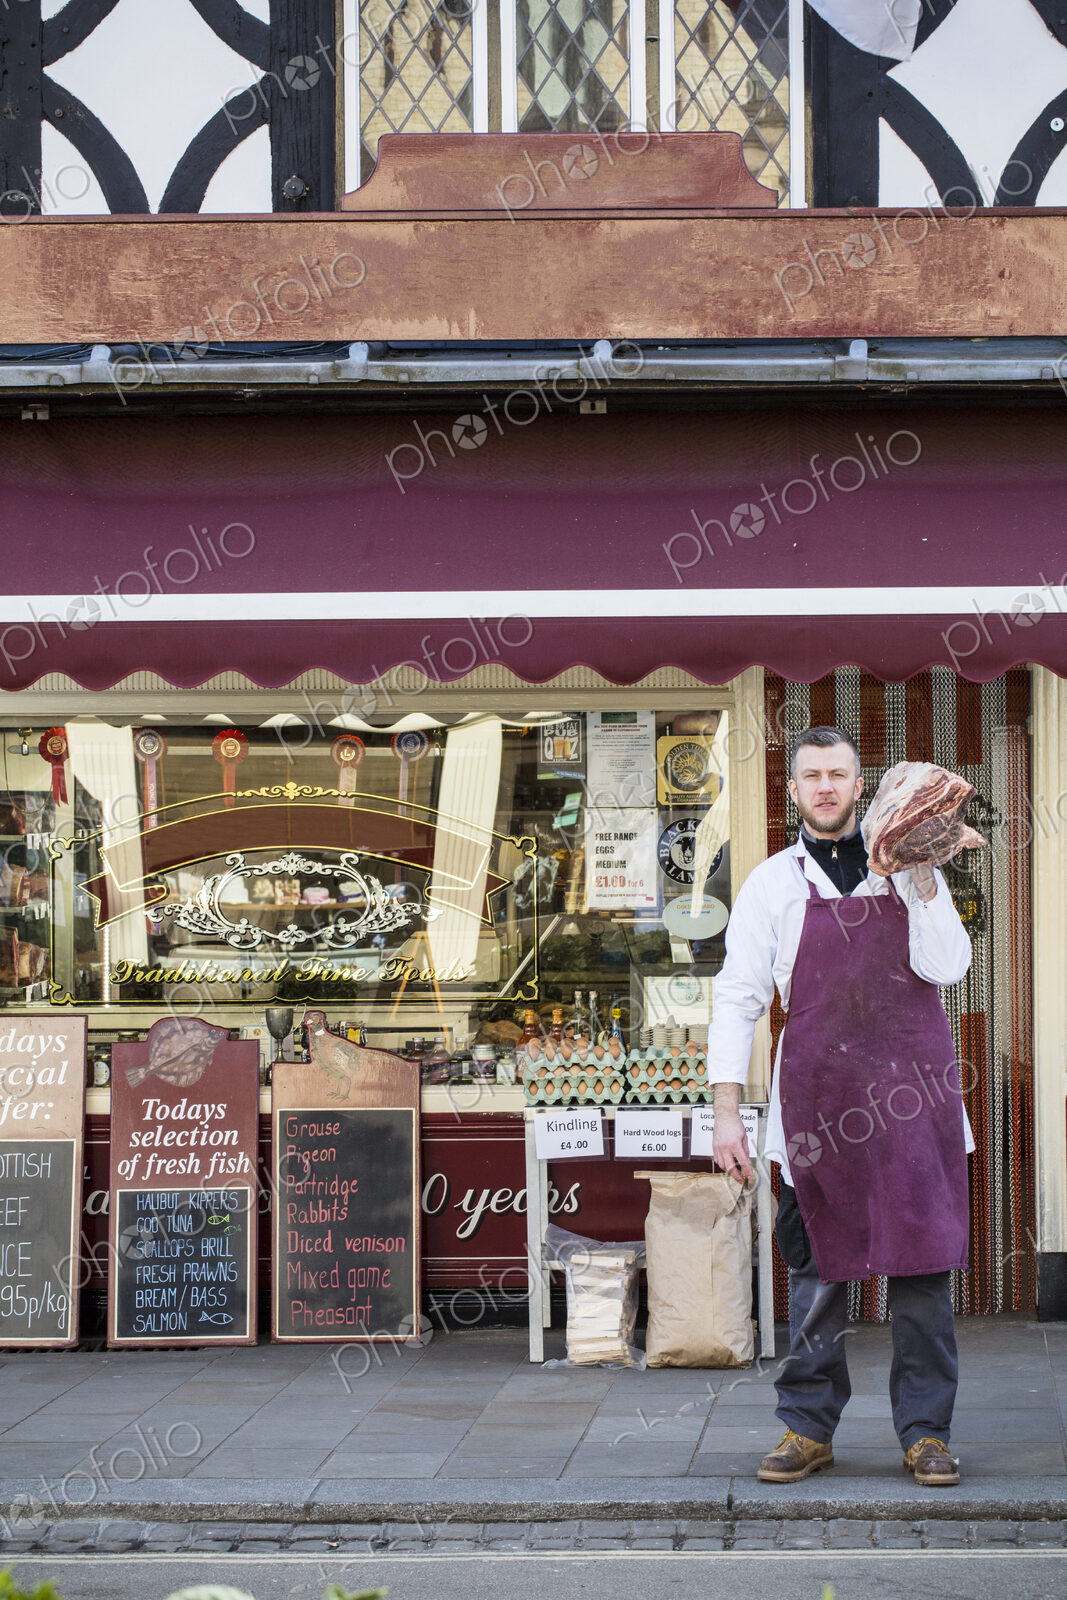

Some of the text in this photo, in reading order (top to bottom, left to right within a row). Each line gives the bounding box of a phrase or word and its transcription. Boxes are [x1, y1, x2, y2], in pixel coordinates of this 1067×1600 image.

[544, 729, 578, 737] PUB
[595, 832, 638, 841] FREE RANGE
[595, 846, 615, 855] EGGS
[595, 860, 627, 869] MEDIUM
[109, 954, 474, 985] Traditional Fine Foods
[142, 1098, 227, 1125] Todays
[129, 1125, 239, 1149] selection
[286, 1116, 341, 1138] Grouse
[546, 1119, 598, 1133] Kindling
[666, 1129, 682, 1138] logs
[286, 1145, 336, 1172] Pigeon
[641, 1143, 667, 1152] £6.00
[117, 1153, 141, 1181] of
[141, 1152, 200, 1181] fresh
[204, 1151, 251, 1180] fish
[286, 1174, 359, 1204] Partridge
[136, 1193, 180, 1211] HALIBUT
[188, 1191, 239, 1210] KIPPERS
[286, 1198, 348, 1225] Rabbits
[136, 1214, 193, 1233] COD TUNA
[134, 1237, 233, 1258] SCALLOPS BRILL
[286, 1230, 406, 1254] Diced venison
[136, 1262, 238, 1285] FRESH PRAWNS
[287, 1261, 392, 1302] Mixed game
[133, 1312, 188, 1333] SALMON
[291, 1296, 373, 1327] Pheasant
